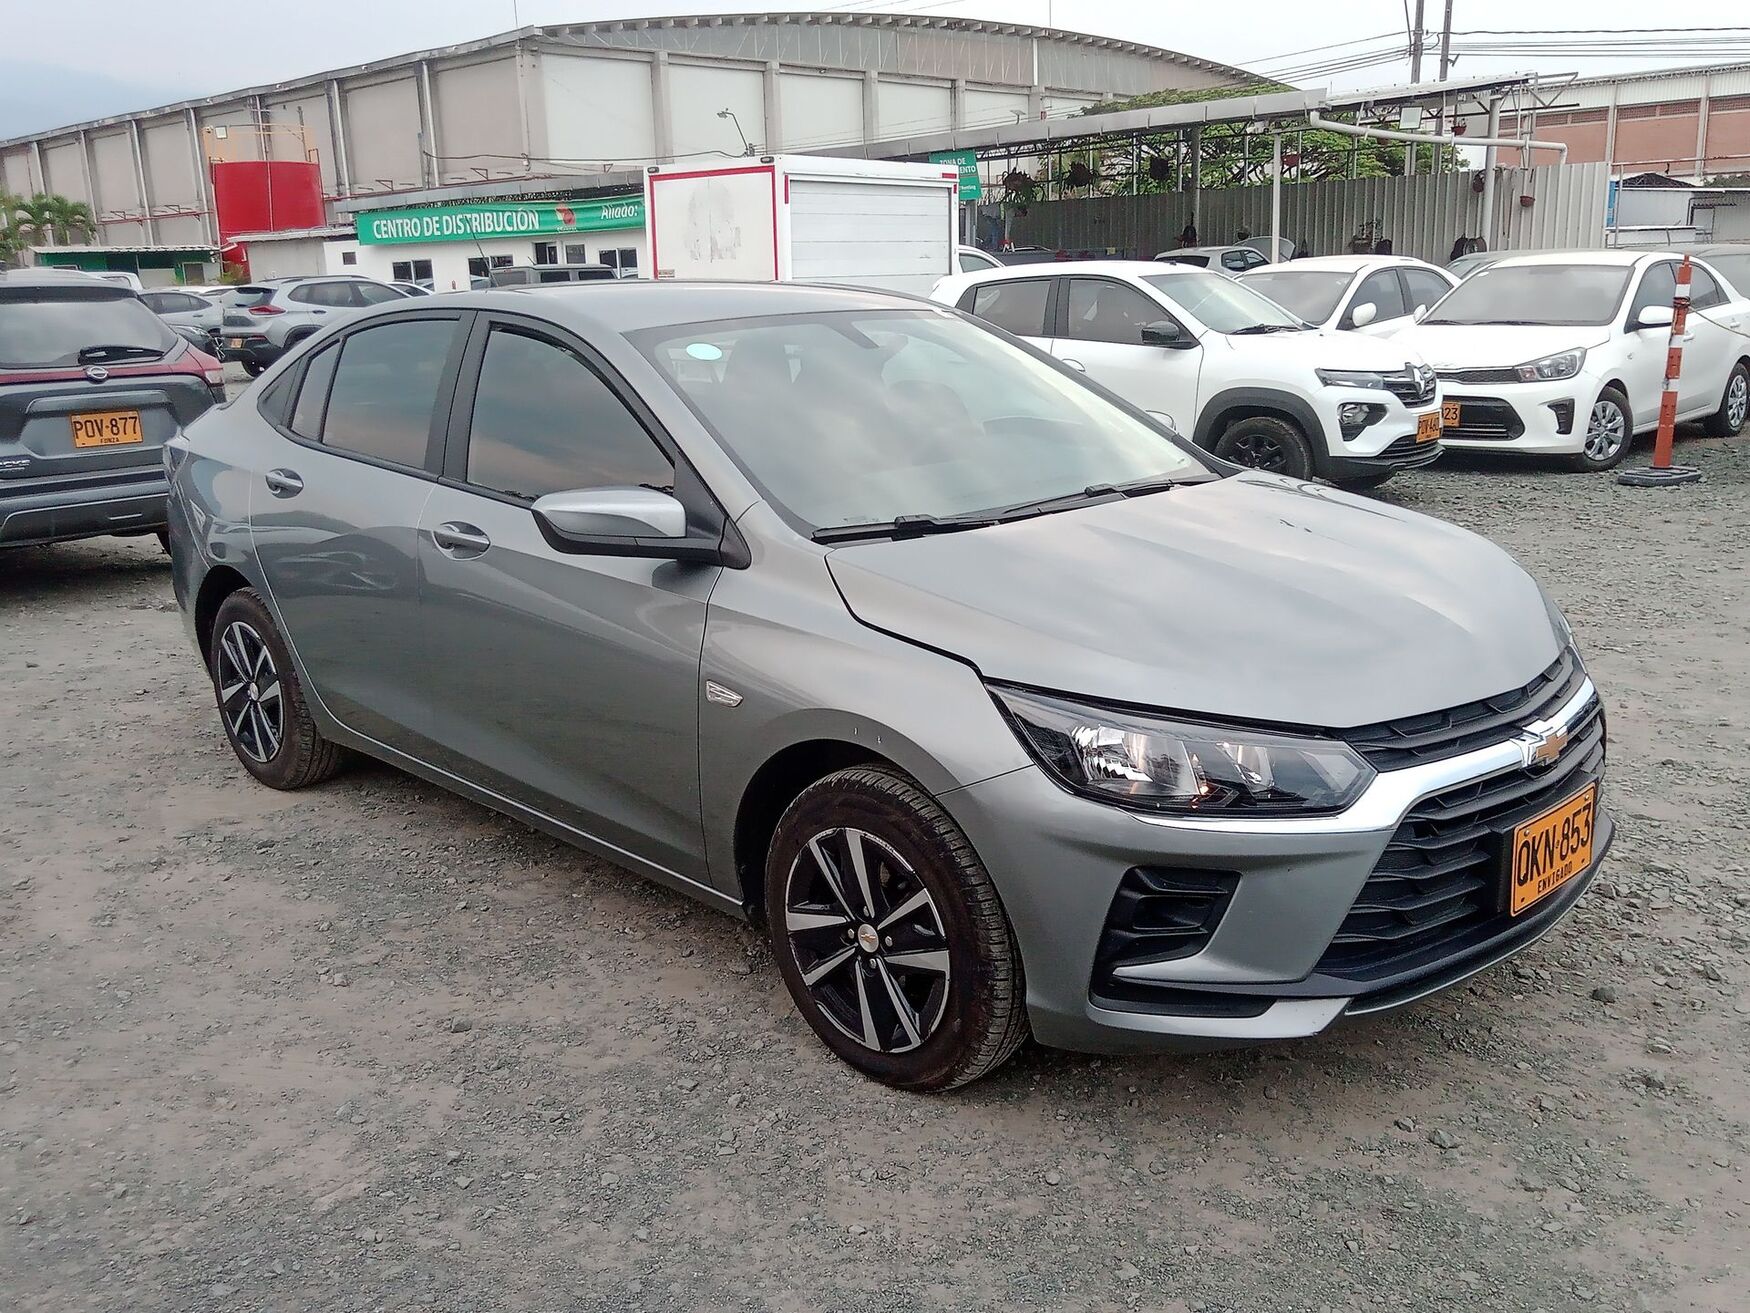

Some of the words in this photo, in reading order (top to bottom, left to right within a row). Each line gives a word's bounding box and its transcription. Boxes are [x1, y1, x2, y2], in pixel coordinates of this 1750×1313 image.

[960, 165, 976, 173] ENTO
[373, 216, 421, 239] CENTRO
[423, 215, 441, 238] DE
[442, 207, 540, 235] DISTRIBUCIÓN
[1537, 861, 1573, 895] ENVIGADO
